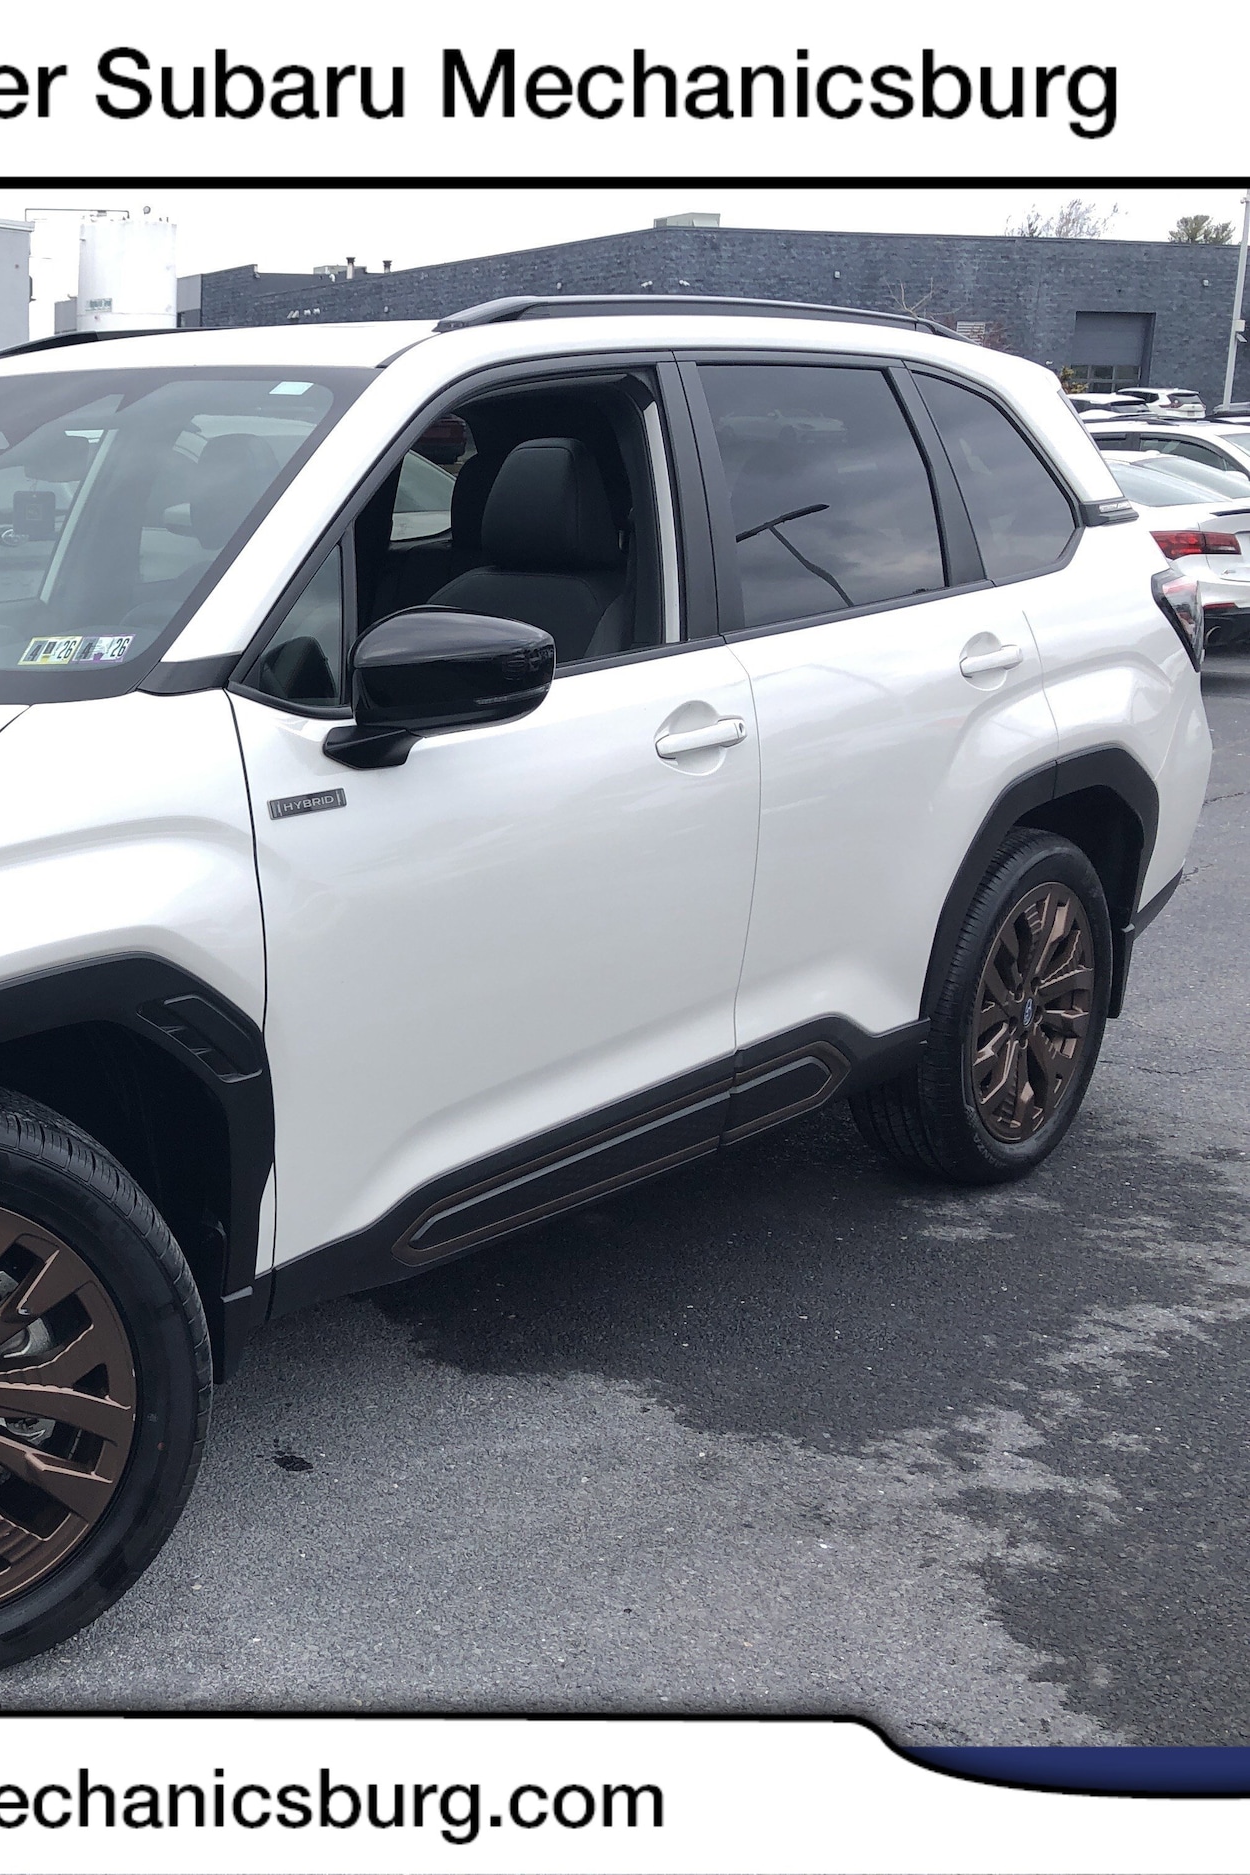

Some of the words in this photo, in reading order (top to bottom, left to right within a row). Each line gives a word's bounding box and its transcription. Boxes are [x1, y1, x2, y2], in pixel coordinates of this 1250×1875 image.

[56, 640, 77, 659] 26
[110, 638, 130, 657] 26
[283, 795, 334, 812] HYBRID
